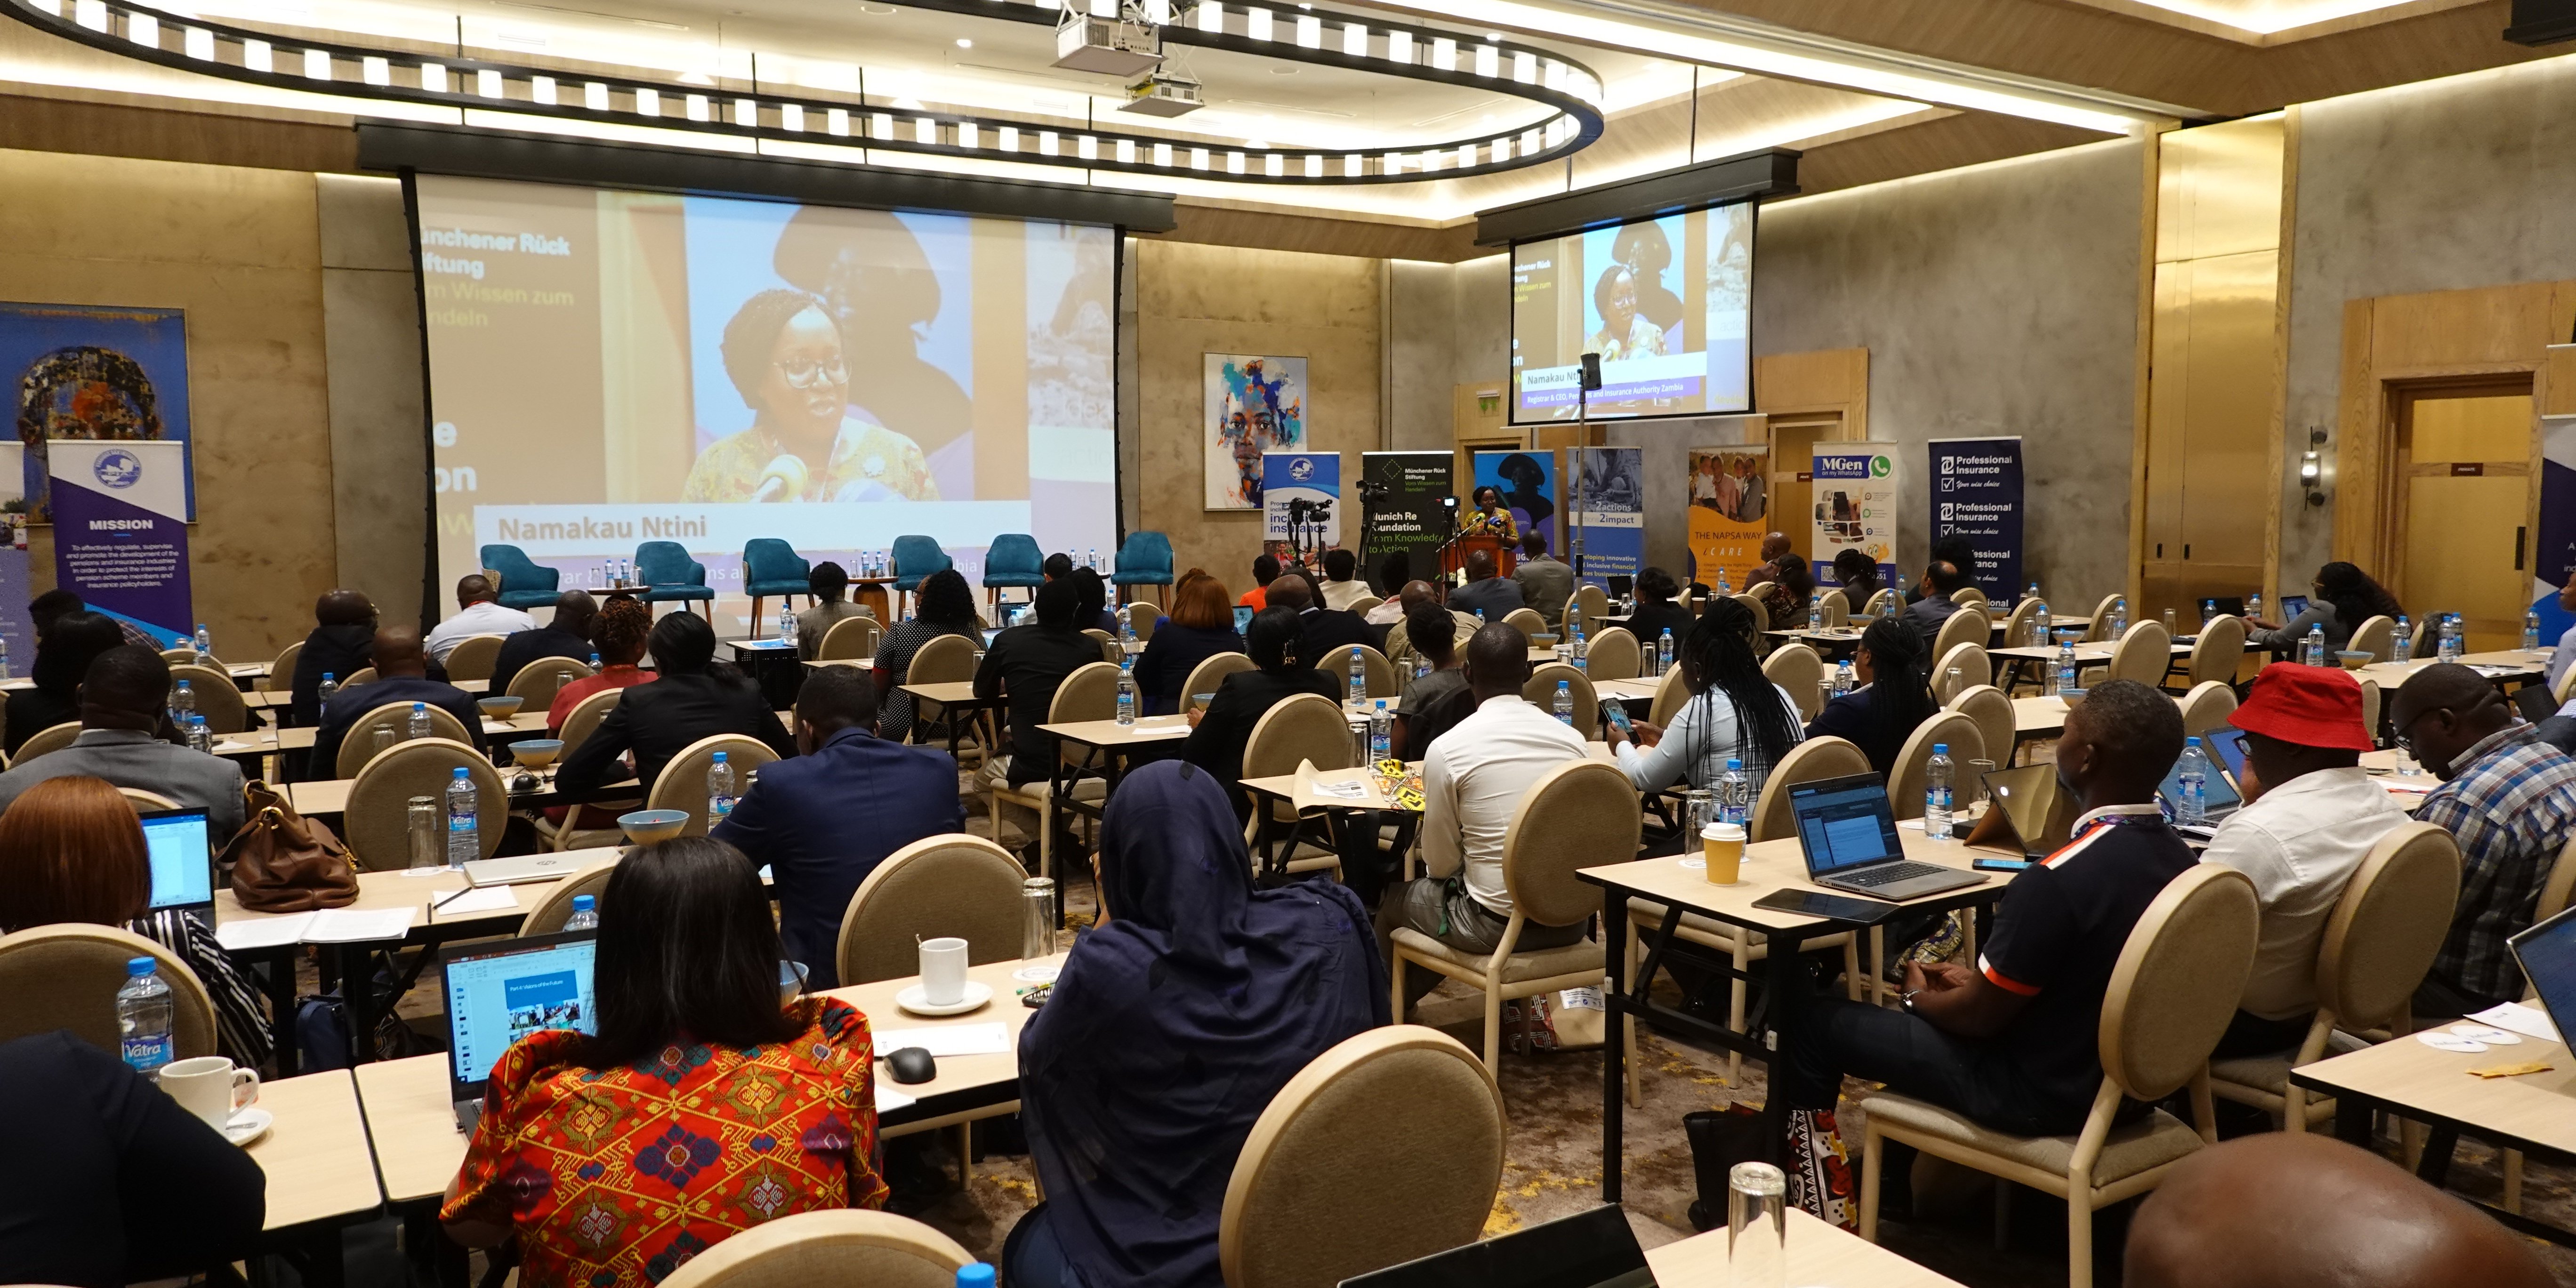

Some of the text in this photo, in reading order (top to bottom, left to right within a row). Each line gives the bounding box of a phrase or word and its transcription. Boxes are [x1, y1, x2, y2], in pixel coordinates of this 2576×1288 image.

[520, 233, 570, 256] Rück
[451, 282, 527, 303] Wissen
[532, 290, 574, 306] zum
[1528, 373, 1564, 385] Namakau
[1527, 395, 1549, 404] Registrar
[1605, 387, 1632, 396] Insurance
[1633, 386, 1659, 394] Authority
[1661, 383, 1683, 392] Zambia
[1821, 458, 1863, 470] MGen
[1956, 455, 2012, 465] Professional
[1956, 466, 2000, 474] Insurance
[1956, 502, 2012, 512] Professional
[1405, 511, 1417, 520] Re
[1956, 513, 1998, 521] Insurance
[89, 519, 153, 530] MISSION
[499, 516, 632, 540] Namakau
[642, 515, 707, 538] Ntini
[1695, 531, 1762, 539] THE NAPSA WAY
[124, 1044, 161, 1058] Vatra
